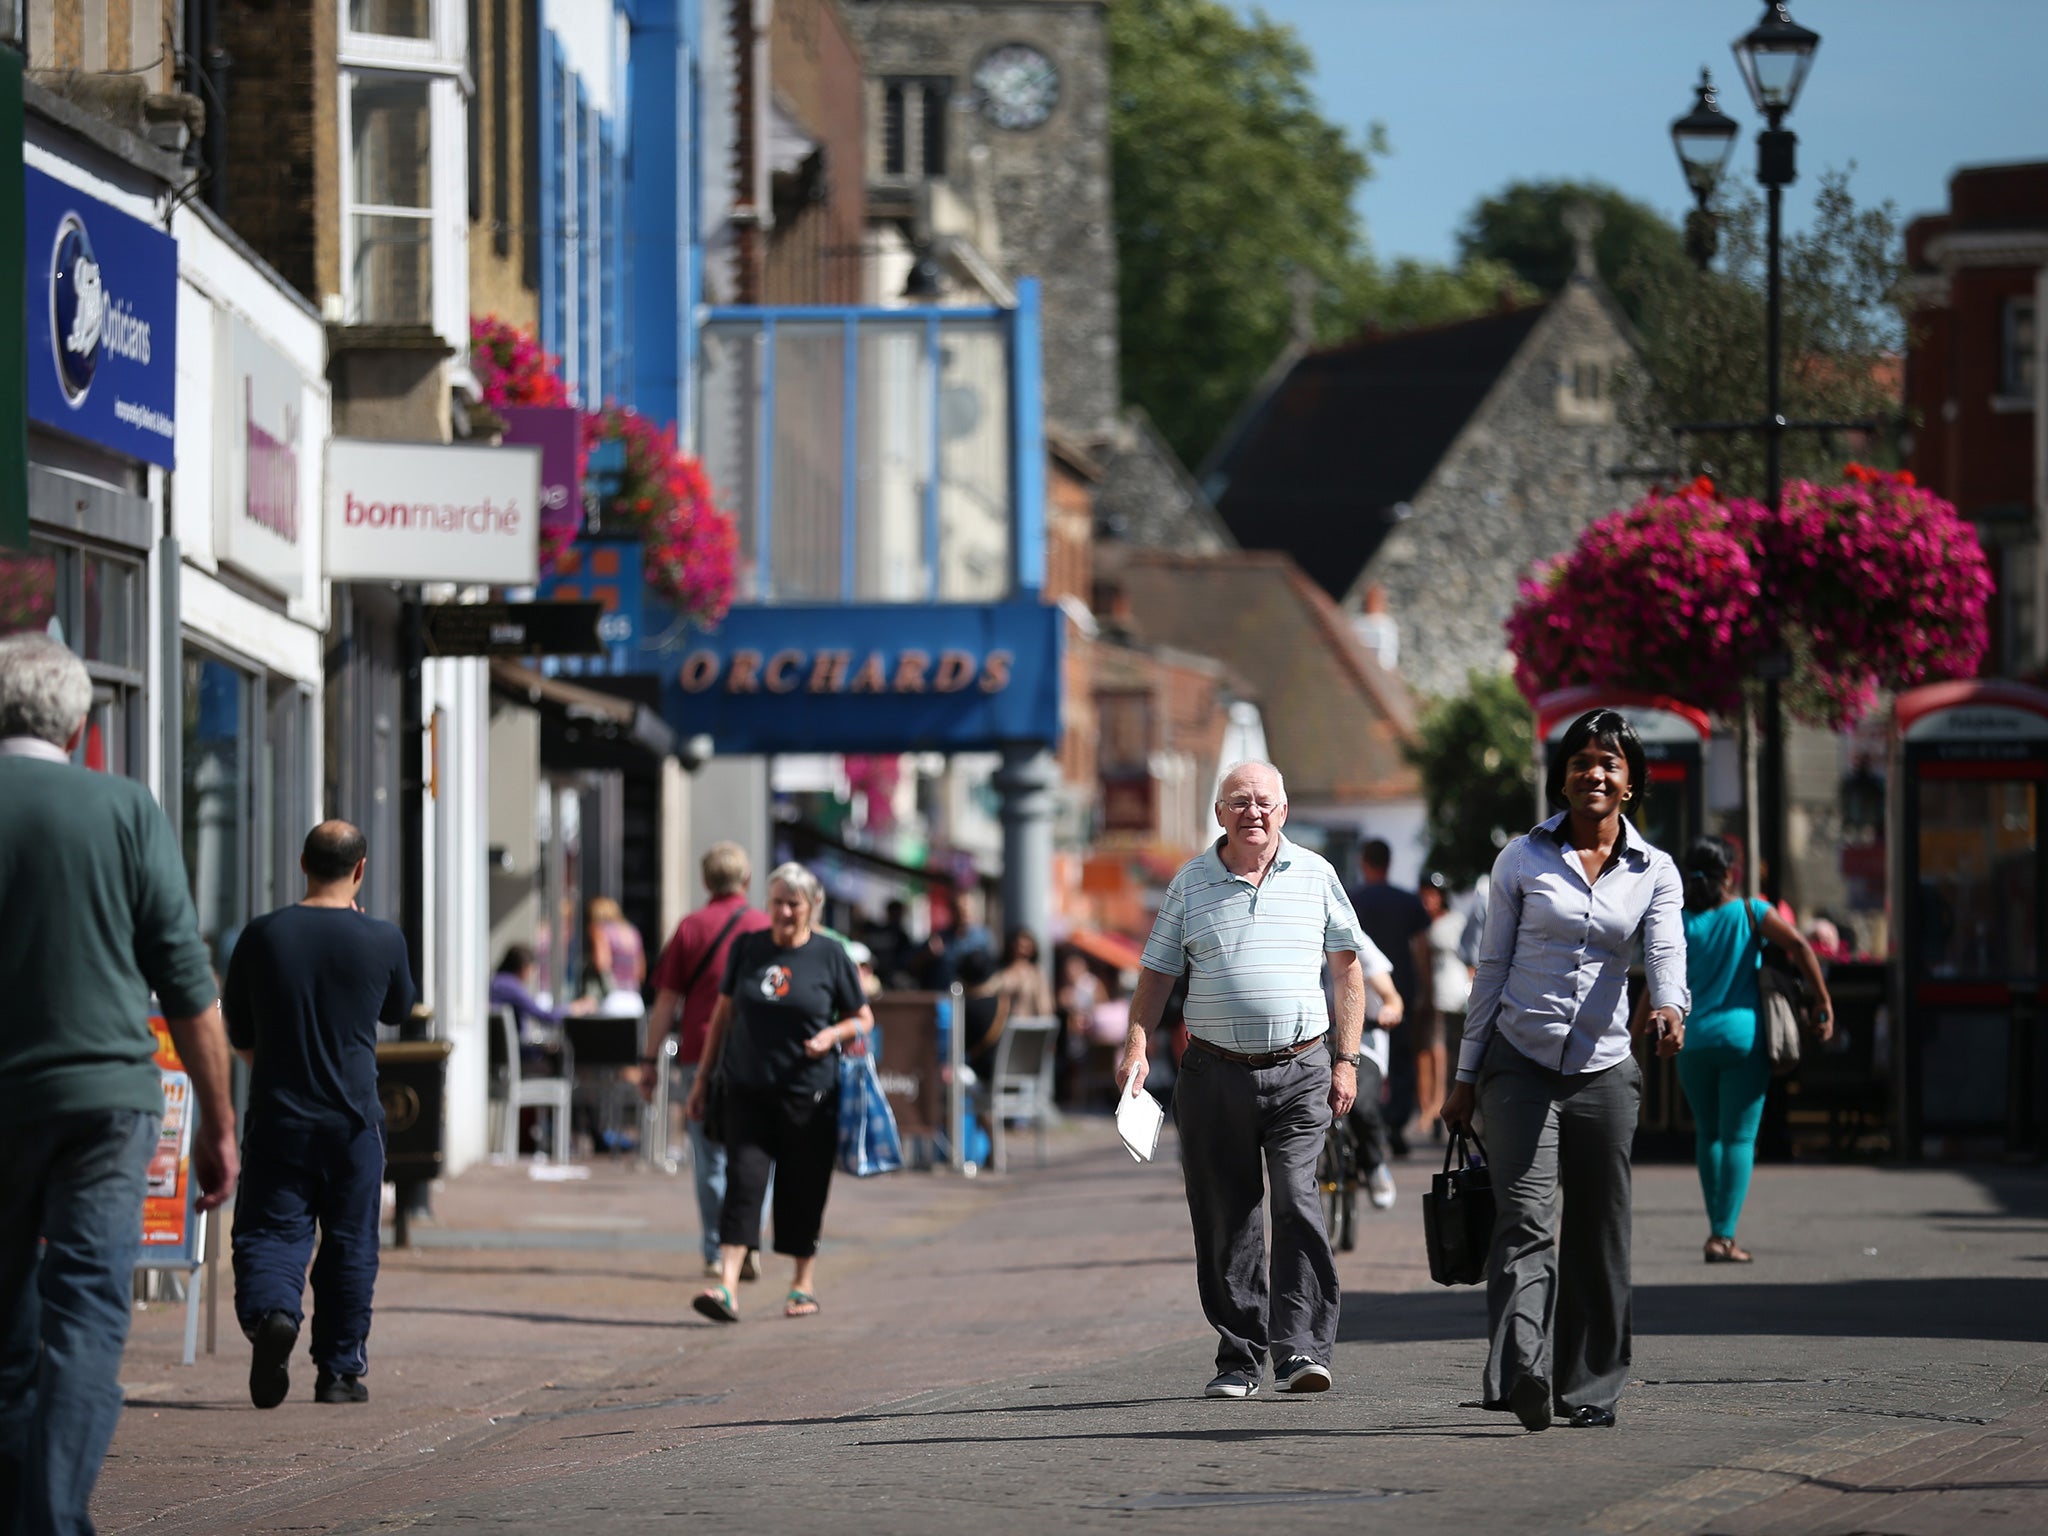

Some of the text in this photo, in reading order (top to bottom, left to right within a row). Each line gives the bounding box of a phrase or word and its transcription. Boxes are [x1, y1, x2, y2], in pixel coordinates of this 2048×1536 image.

[102, 290, 151, 365] Opticians
[344, 489, 520, 536] bonmarché
[680, 649, 1013, 694] ORCHARDS
